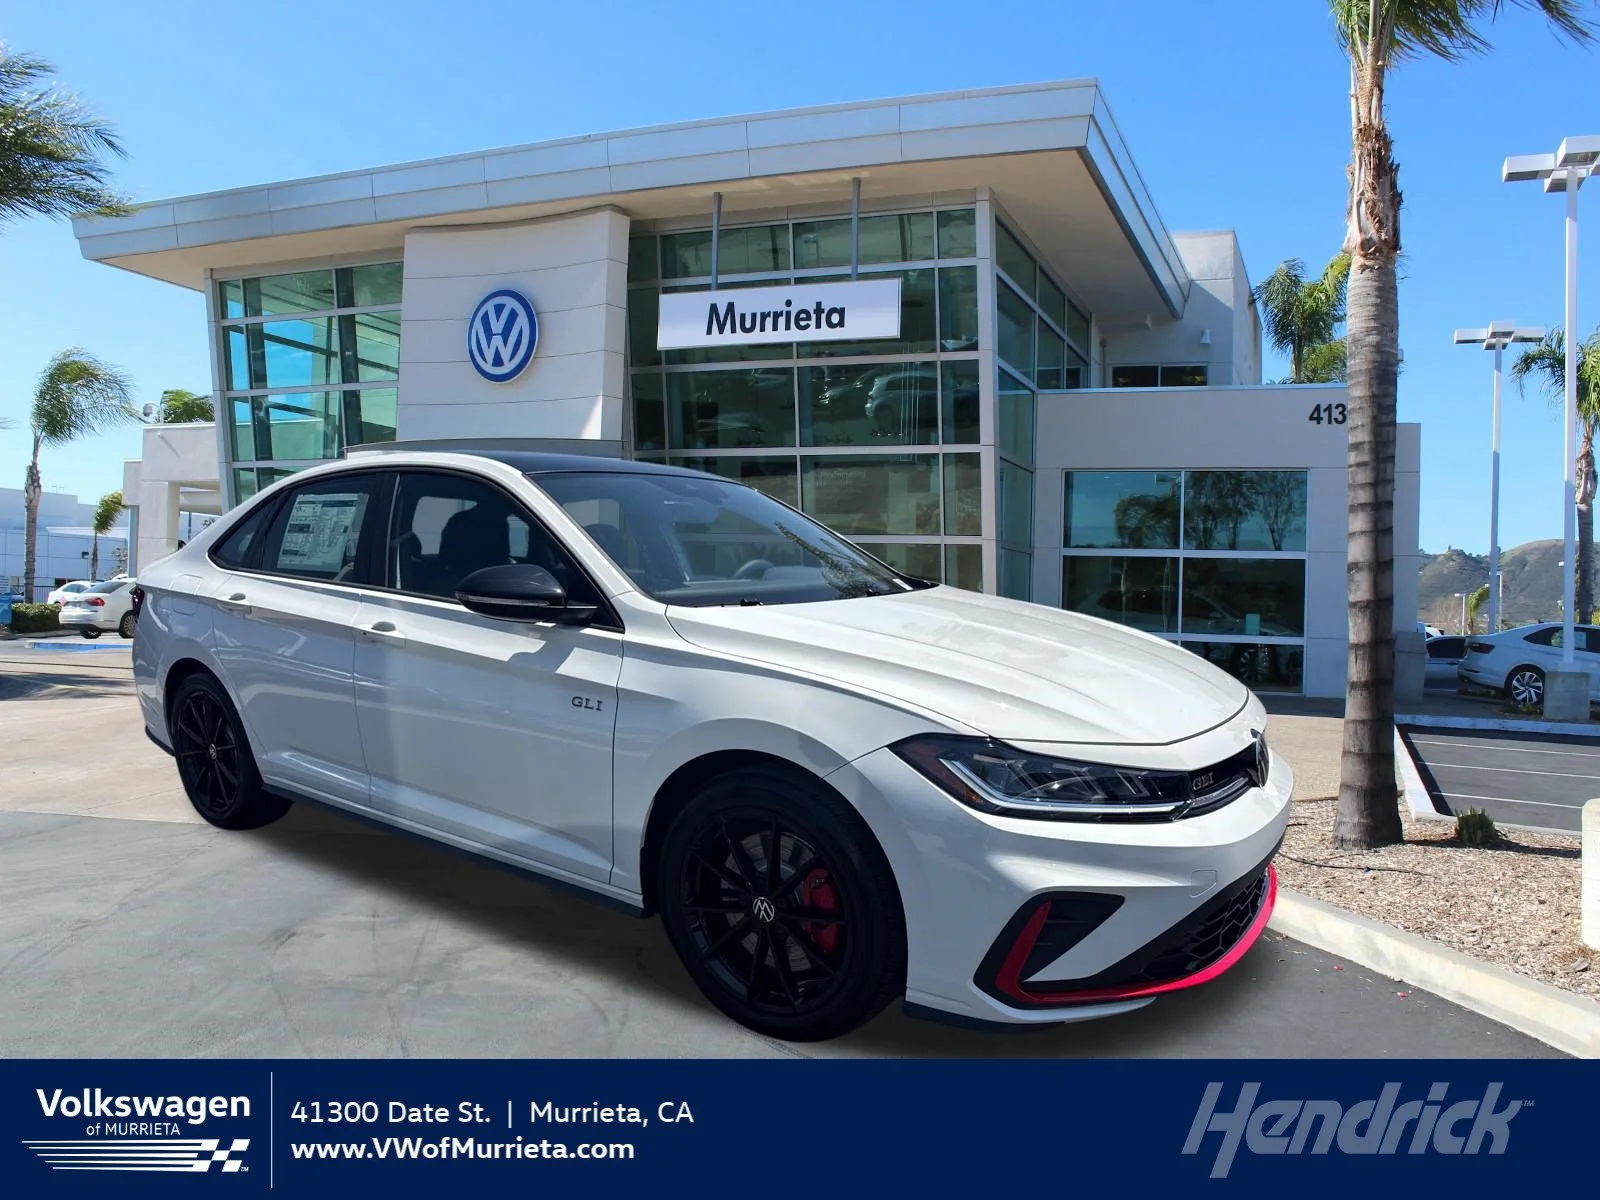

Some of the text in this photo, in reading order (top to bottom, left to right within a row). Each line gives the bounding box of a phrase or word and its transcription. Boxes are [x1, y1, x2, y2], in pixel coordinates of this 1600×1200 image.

[705, 299, 847, 336] Murrieta
[1308, 403, 1347, 425] 413
[571, 695, 604, 712] GLI
[1192, 771, 1215, 791] GLI
